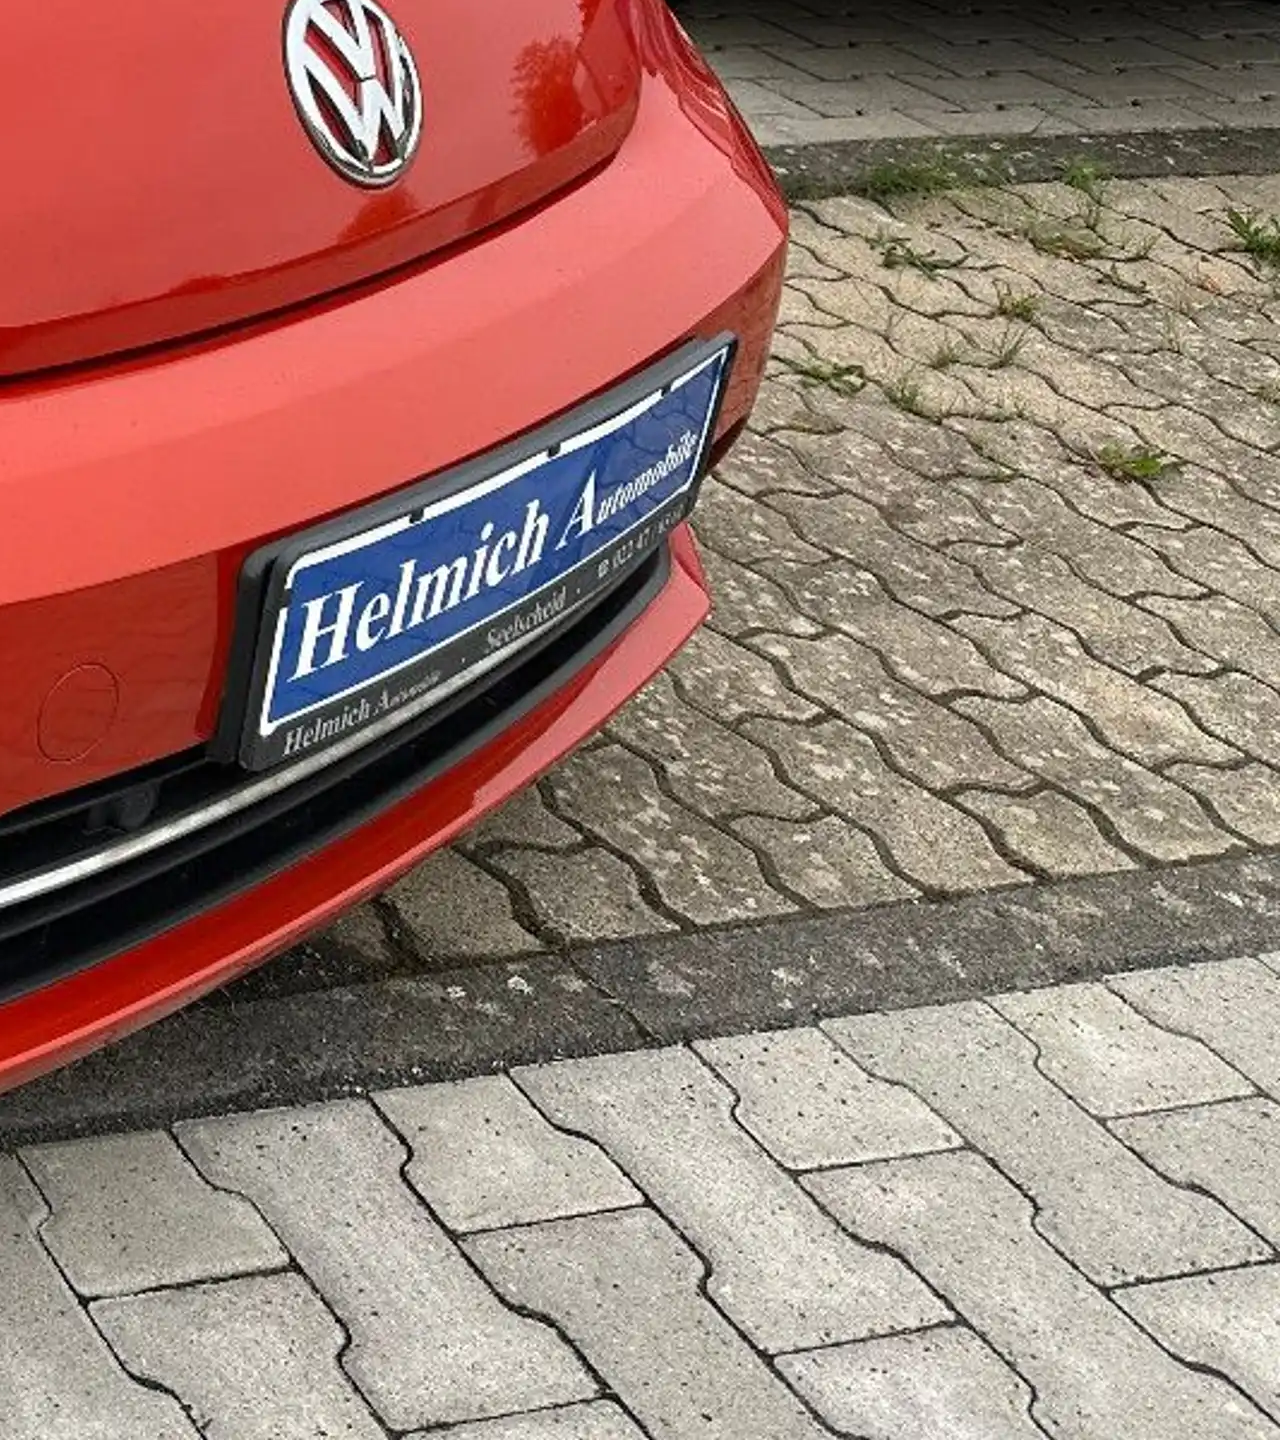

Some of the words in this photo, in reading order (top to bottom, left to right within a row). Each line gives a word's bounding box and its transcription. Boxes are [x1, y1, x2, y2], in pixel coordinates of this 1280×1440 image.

[286, 498, 550, 663] Helmich
[554, 428, 698, 552] Automobile
[280, 698, 372, 758] Helmich
